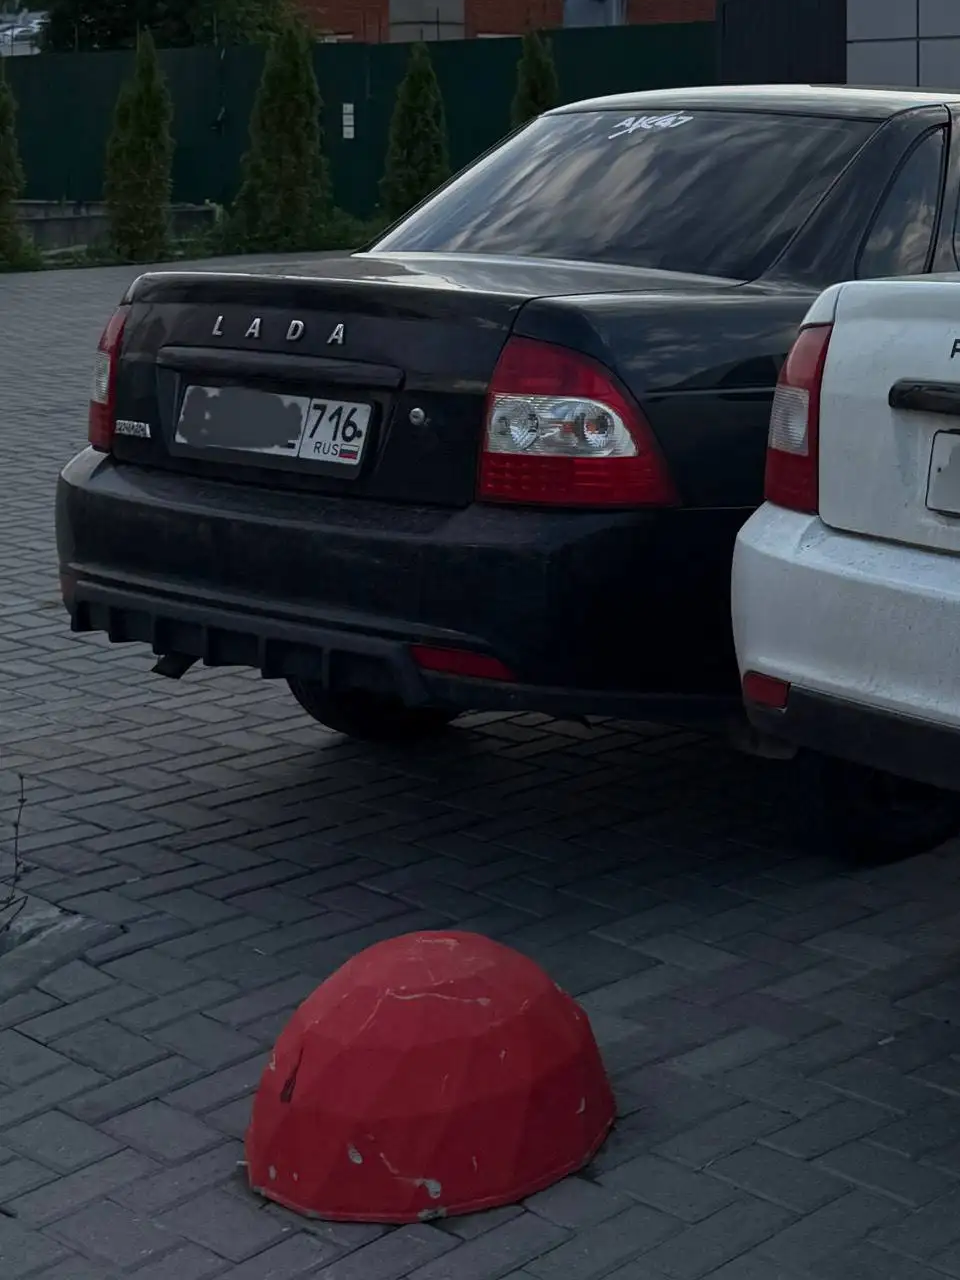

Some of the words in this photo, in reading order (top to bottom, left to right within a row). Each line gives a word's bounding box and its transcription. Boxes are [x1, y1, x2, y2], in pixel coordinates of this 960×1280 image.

[212, 315, 345, 345] LADA
[309, 403, 358, 443] 716
[313, 441, 340, 456] RUS
